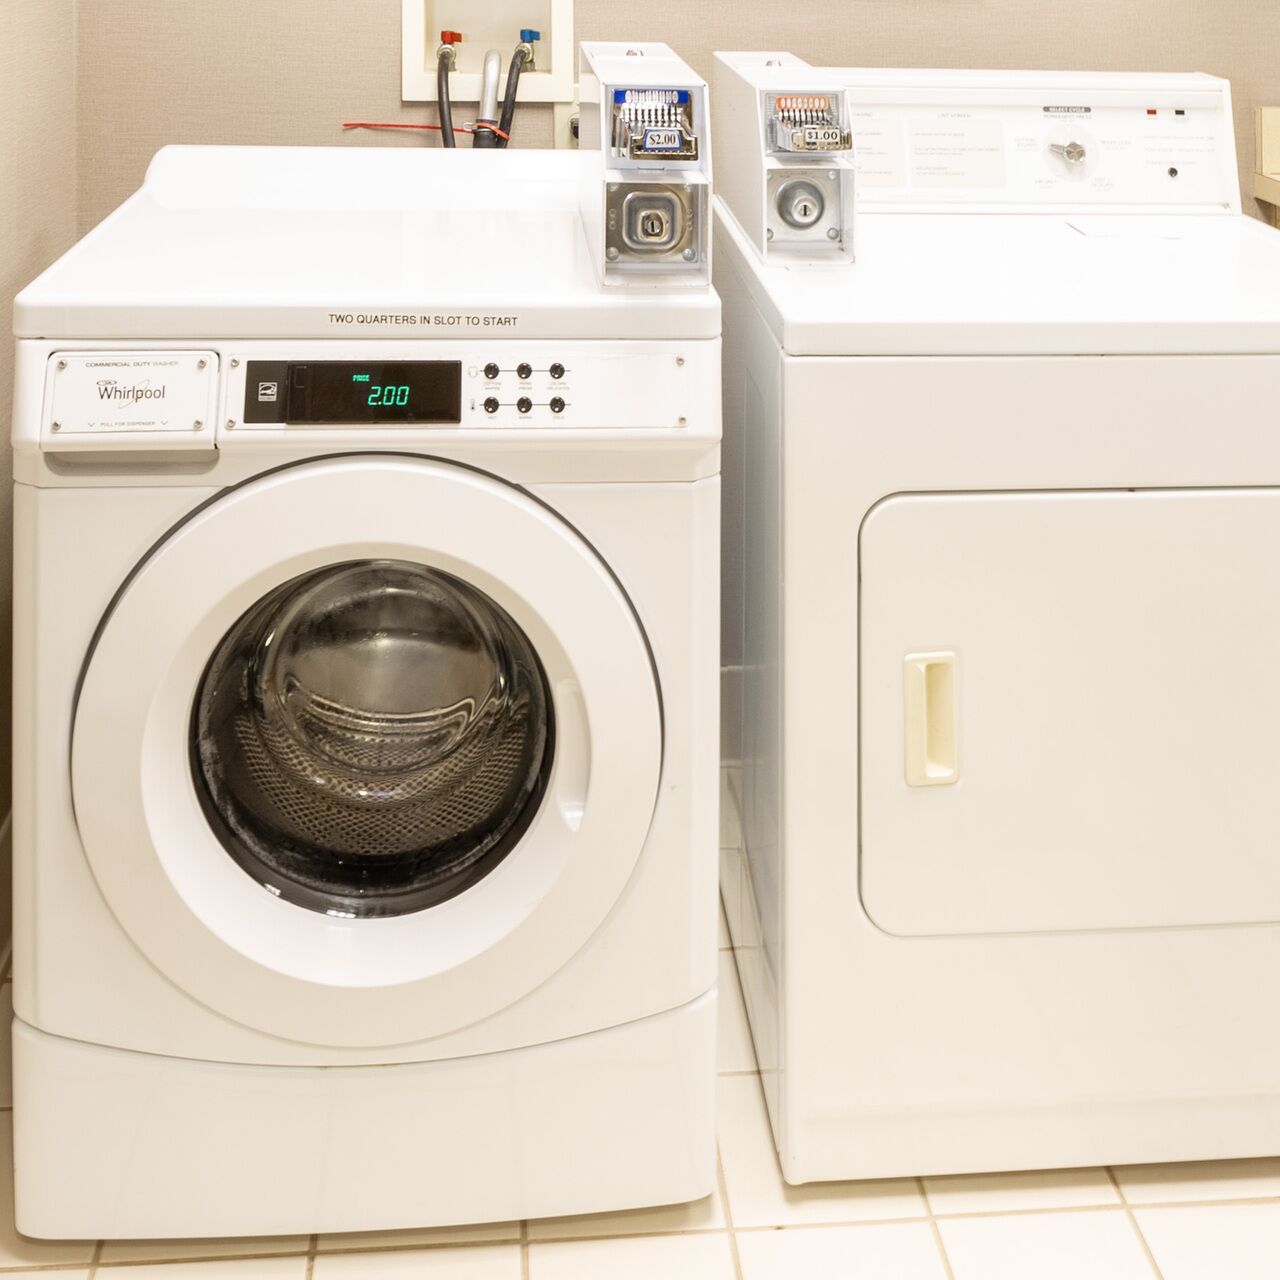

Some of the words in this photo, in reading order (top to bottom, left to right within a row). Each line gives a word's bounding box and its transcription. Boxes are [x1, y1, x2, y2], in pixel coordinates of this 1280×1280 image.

[648, 132, 676, 146] $2.00
[807, 130, 838, 141] $1.00
[328, 314, 354, 324] TWO
[356, 314, 416, 325] QUARTERS
[419, 315, 431, 325] IN
[433, 315, 461, 326] SLOT
[465, 316, 480, 326] TO
[482, 316, 518, 326] START
[98, 385, 166, 403] Whirlpool
[367, 386, 410, 406] 2.00
